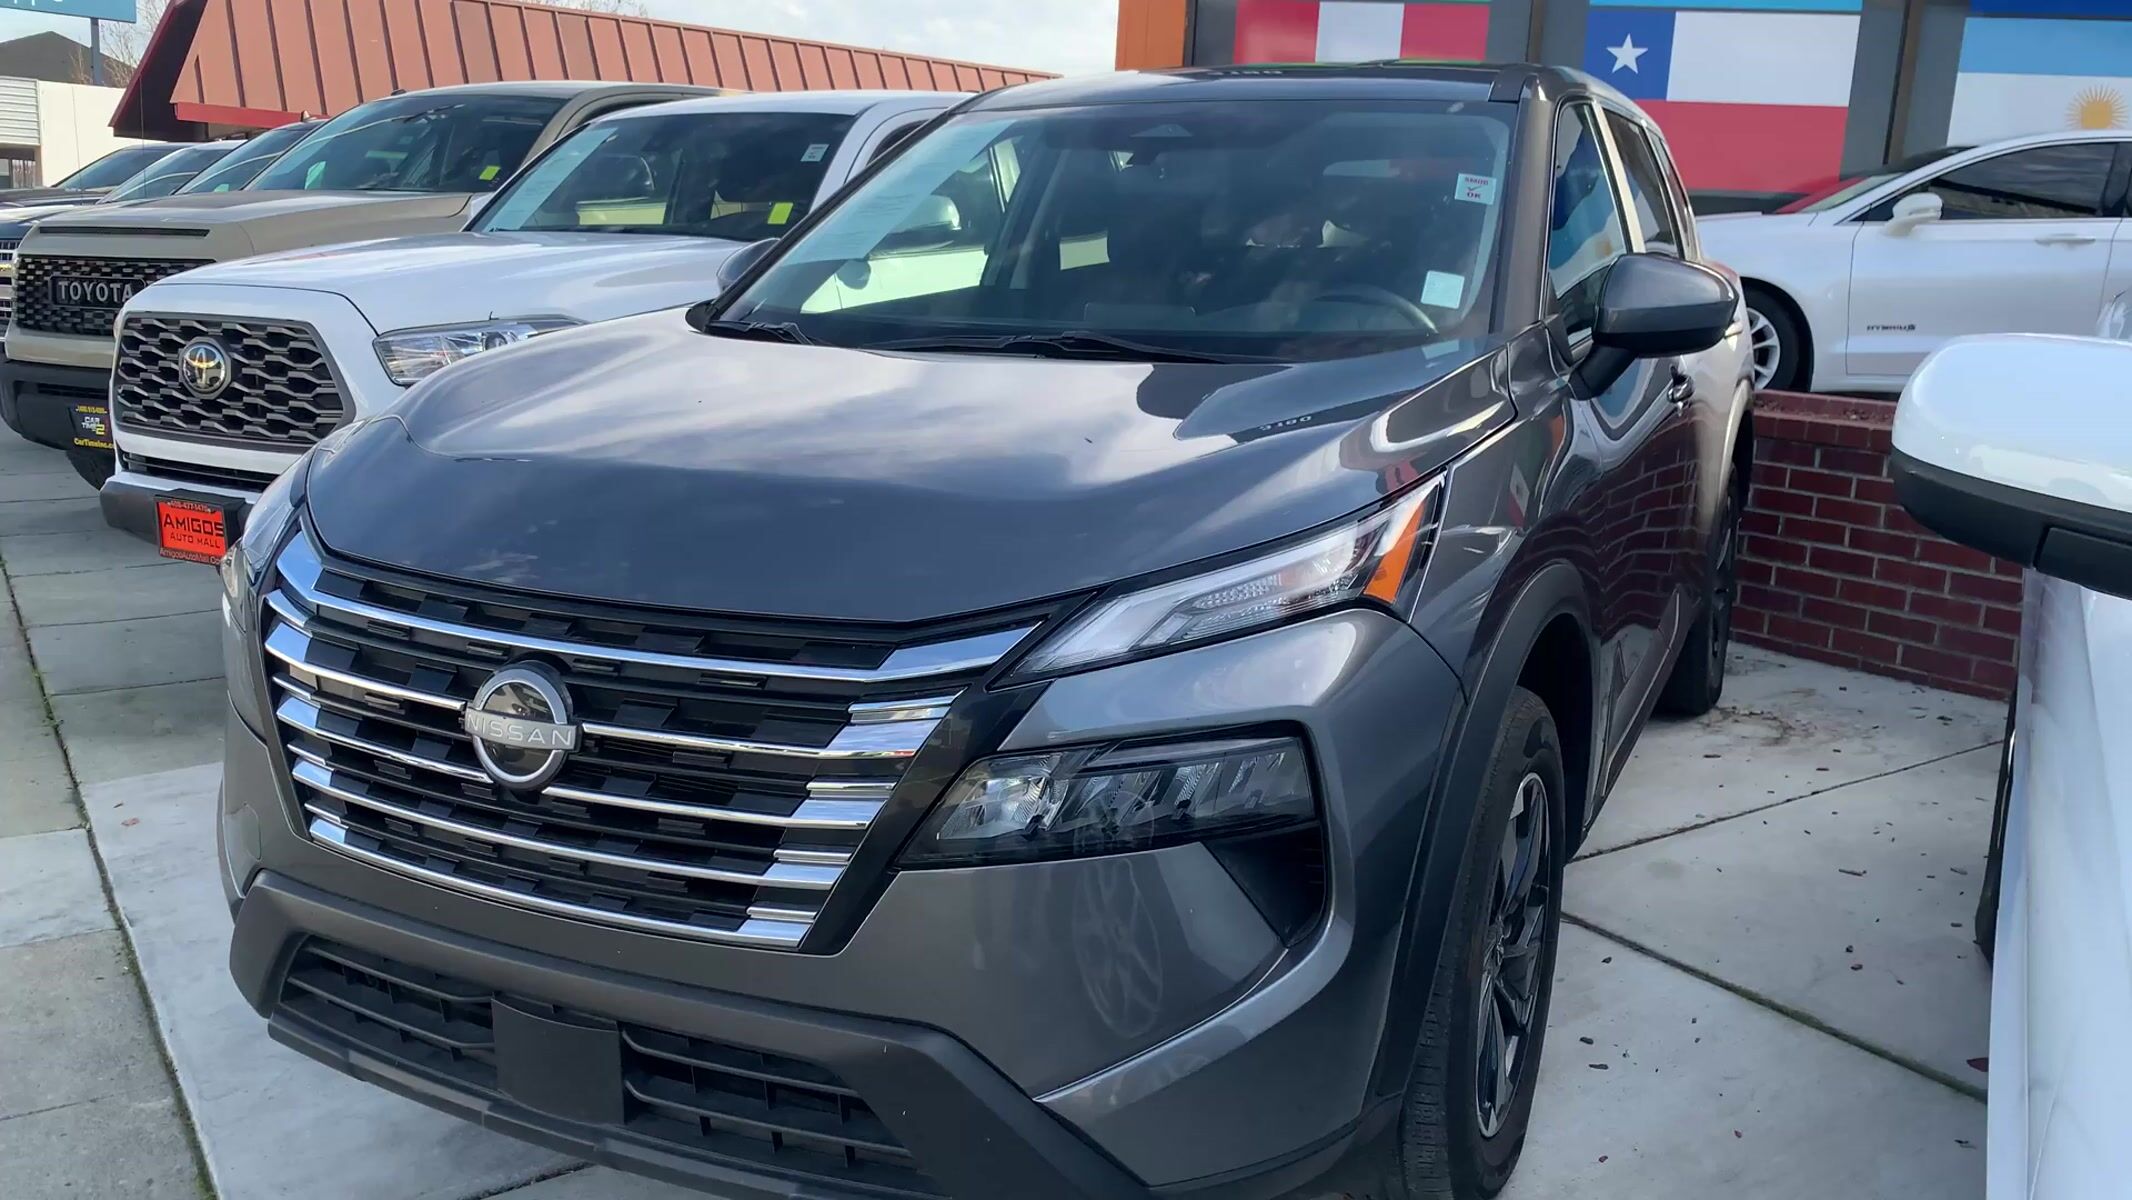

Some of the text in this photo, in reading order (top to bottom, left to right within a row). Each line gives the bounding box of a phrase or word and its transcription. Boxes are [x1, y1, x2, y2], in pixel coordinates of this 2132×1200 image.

[58, 281, 133, 302] TOYOTA
[84, 416, 100, 424] CAR
[95, 424, 105, 435] 2
[163, 513, 224, 537] AMIGOS
[170, 532, 220, 549] AUTO MALL
[466, 714, 572, 746] NISSAN
